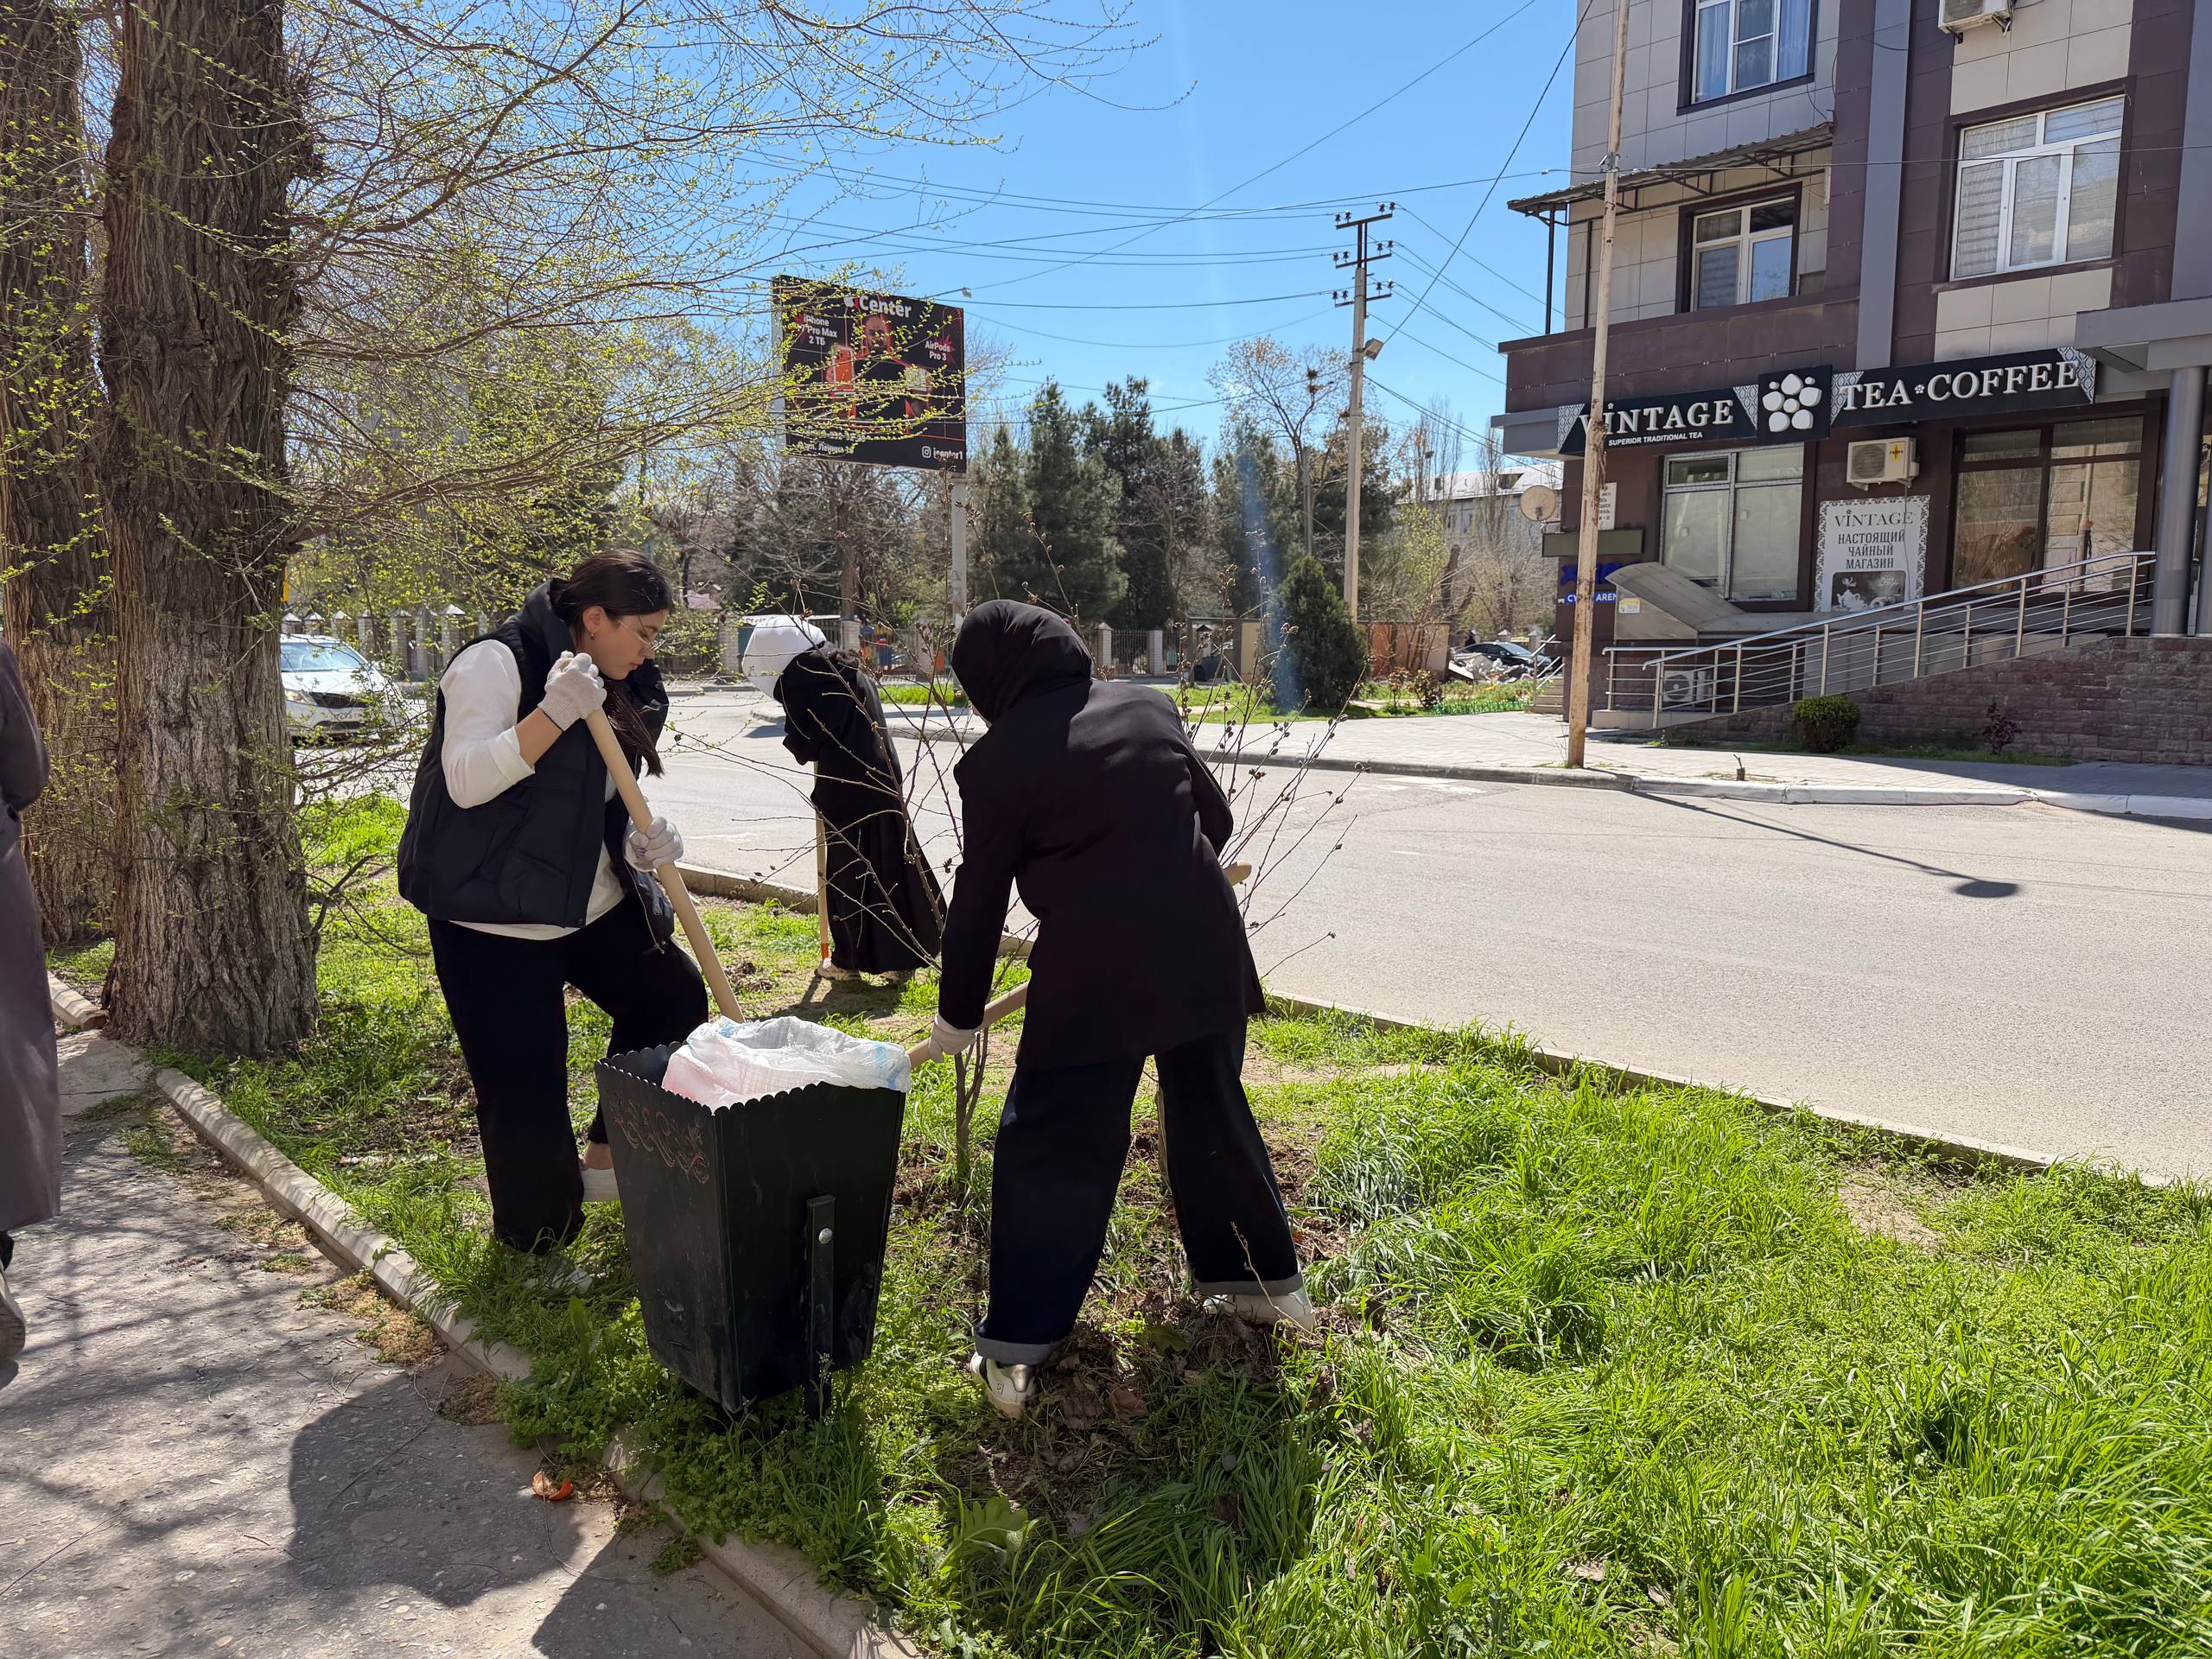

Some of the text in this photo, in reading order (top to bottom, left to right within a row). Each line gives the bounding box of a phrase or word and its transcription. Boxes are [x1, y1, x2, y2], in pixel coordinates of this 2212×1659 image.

[859, 295, 912, 318] Center
[807, 326, 821, 335] Pro
[822, 327, 838, 338] Max
[809, 335, 815, 344] 2
[925, 340, 951, 353] AirPods
[929, 350, 947, 361] Pro 3
[1843, 360, 2081, 410] TEA COFFEE
[1608, 436, 1642, 447] SUPERIOR
[1643, 433, 1688, 443] TRADITIONAL
[1838, 530, 1905, 545] НАСТОЯЩИЙ
[1848, 543, 1893, 556] ЧАЙНЫЙ
[1846, 558, 1894, 569] МАГАЗИН
